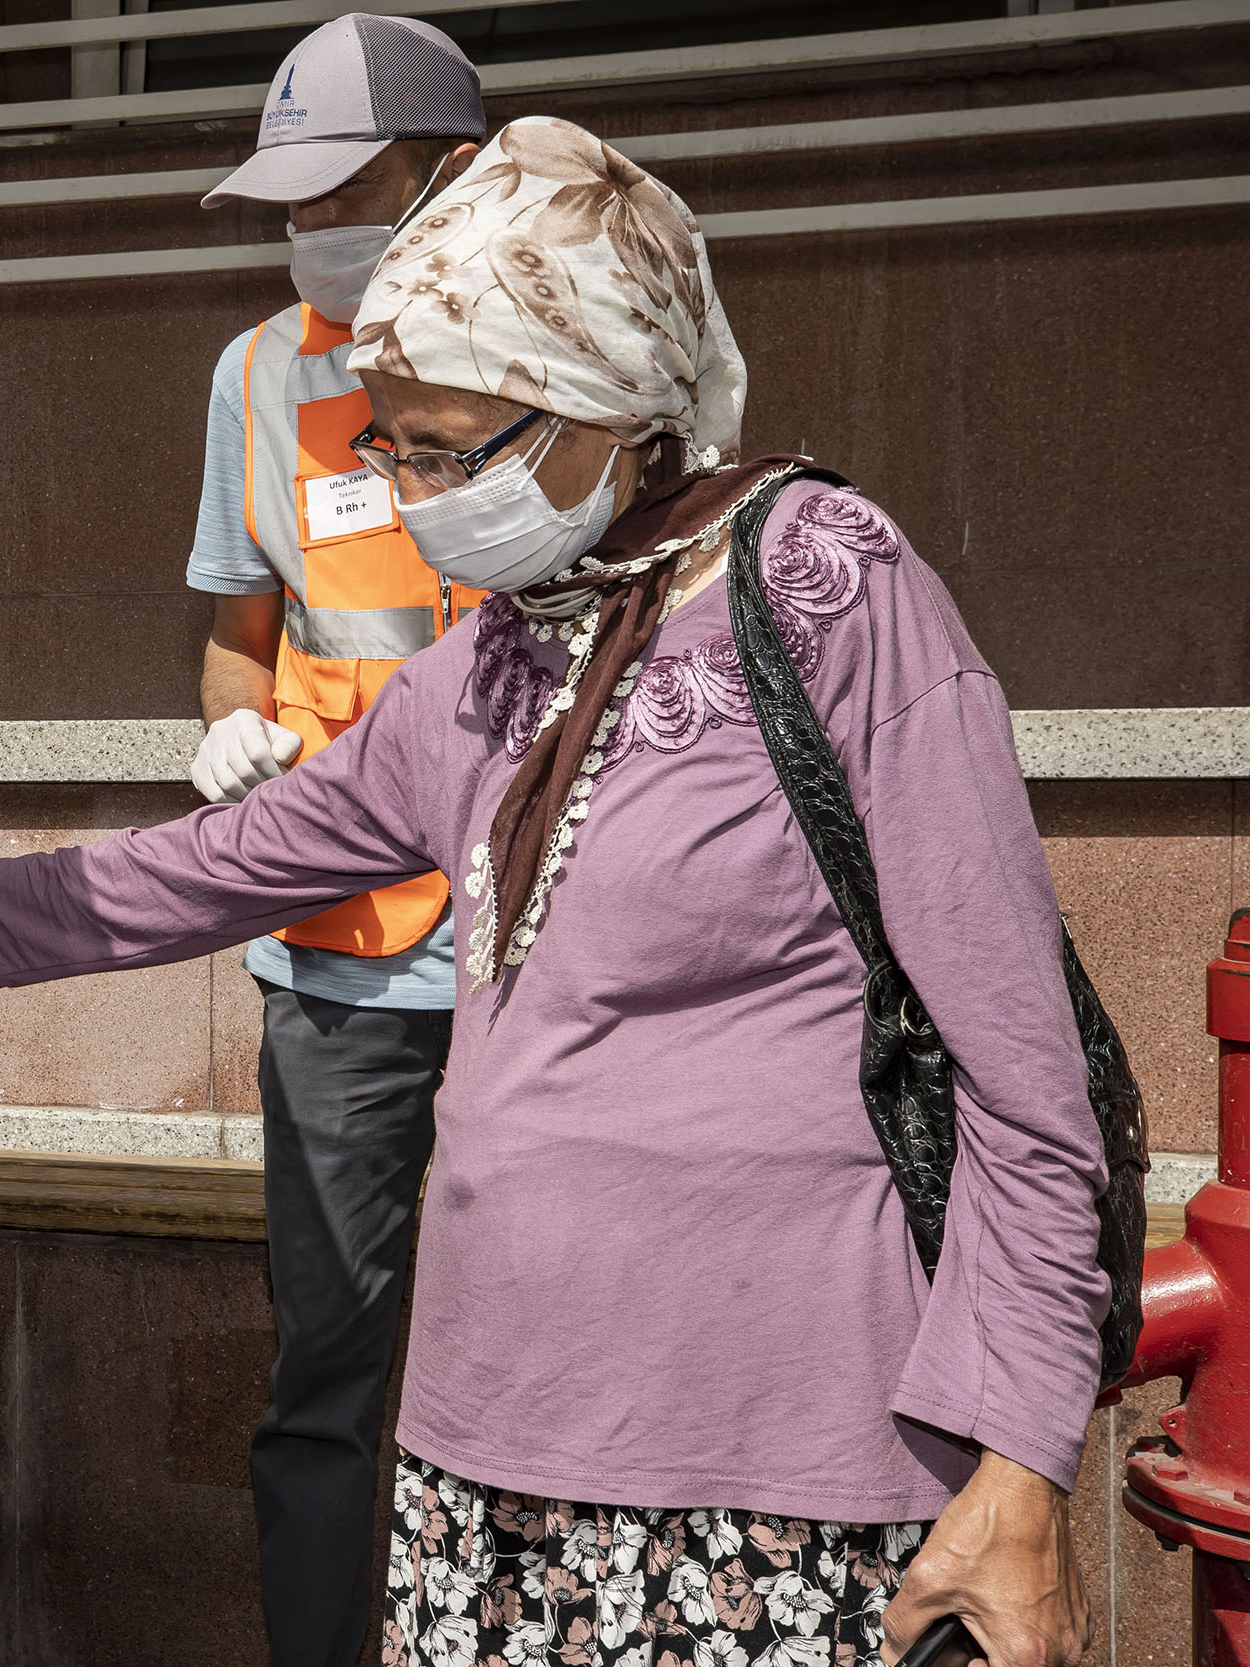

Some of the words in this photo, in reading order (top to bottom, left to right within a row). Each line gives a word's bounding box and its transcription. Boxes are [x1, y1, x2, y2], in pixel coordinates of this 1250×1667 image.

[329, 480, 347, 490] Ufuk
[348, 474, 368, 485] KAYA
[336, 506, 343, 515] B
[346, 502, 359, 513] Rh
